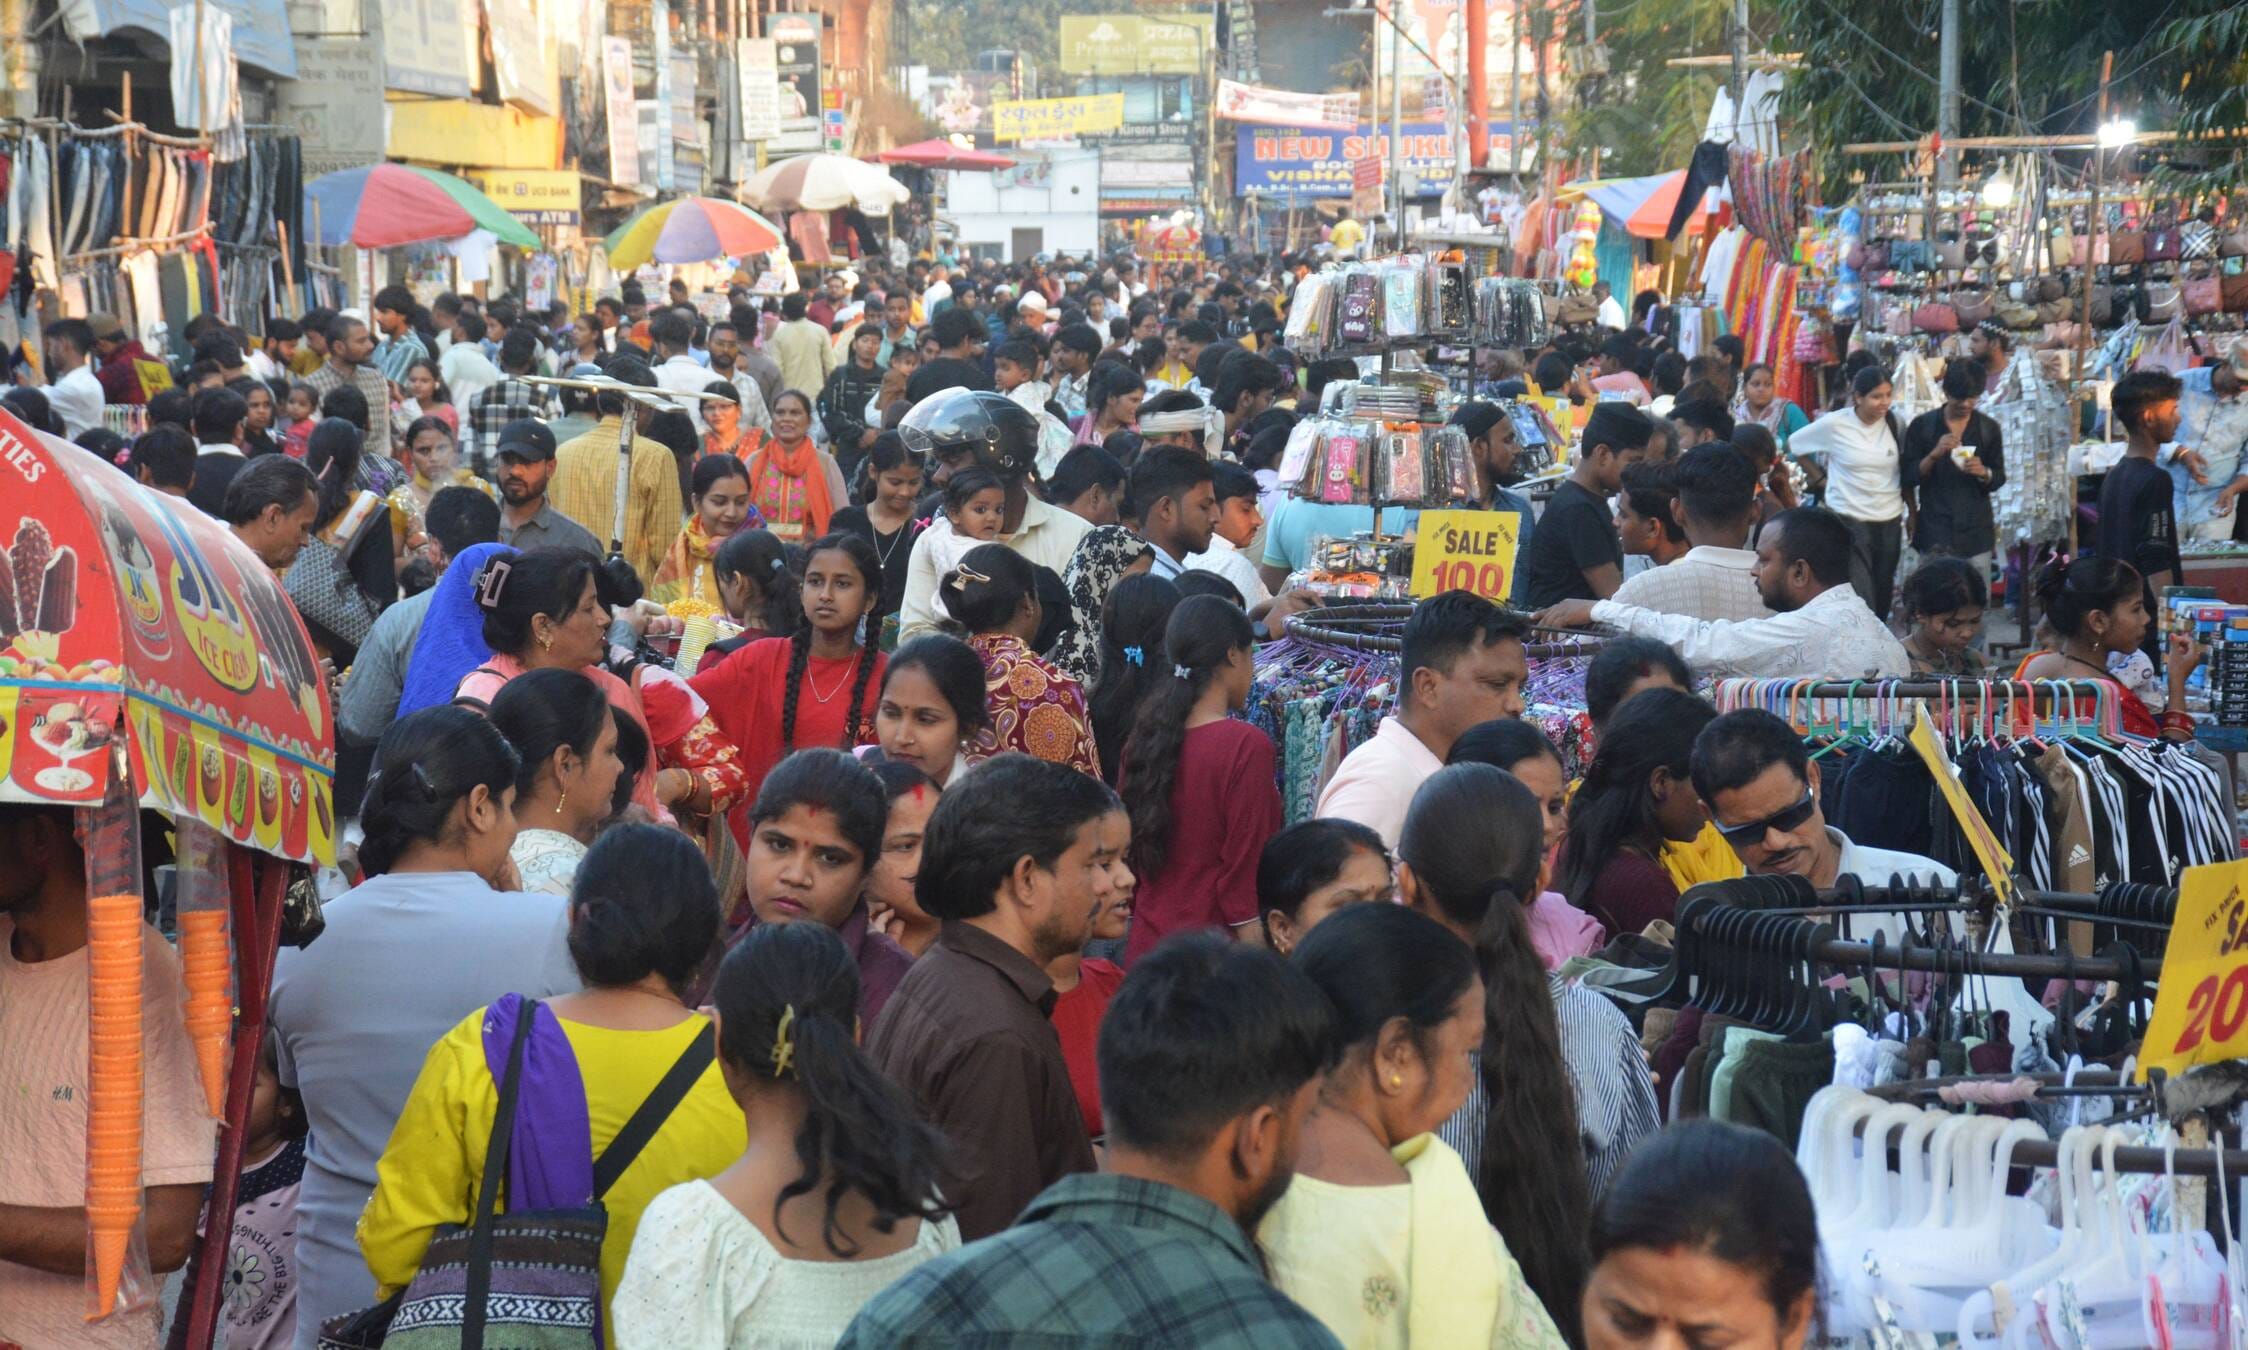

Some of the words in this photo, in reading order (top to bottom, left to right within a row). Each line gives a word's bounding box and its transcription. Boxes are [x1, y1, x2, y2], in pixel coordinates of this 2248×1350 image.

[1253, 135, 1333, 161] NEW
[541, 210, 571, 223] ATM
[1444, 528, 1499, 556] SALE
[1432, 560, 1504, 598] 100
[2204, 911, 2219, 931] FIX
[271, 1255, 288, 1279] BIG
[269, 1281, 288, 1307] THE
[250, 1304, 273, 1328] ARE
